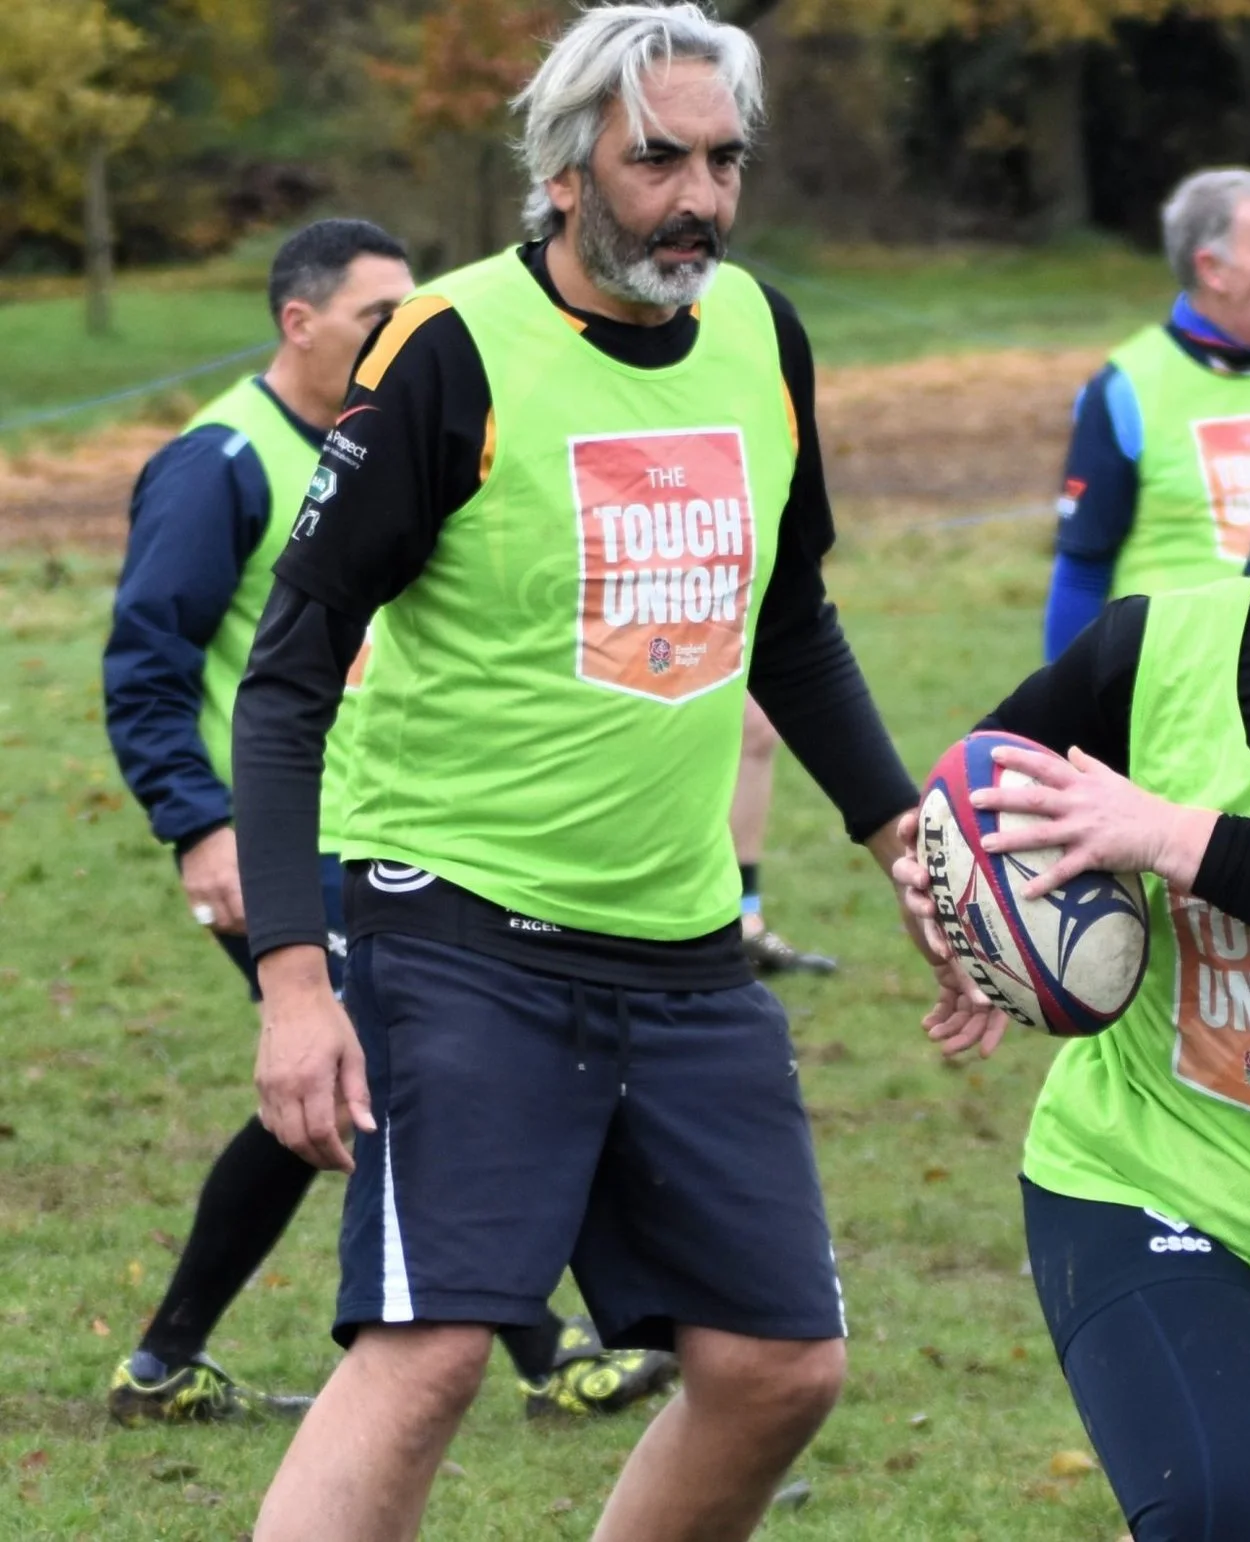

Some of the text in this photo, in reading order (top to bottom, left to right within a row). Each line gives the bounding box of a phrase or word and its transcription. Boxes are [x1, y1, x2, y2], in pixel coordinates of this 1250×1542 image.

[646, 467, 686, 488] THE
[593, 498, 743, 562] TOUCH
[603, 565, 739, 627] UNION
[509, 917, 562, 933] EXCEL
[924, 816, 1036, 1028] GILBERT
[1149, 1235, 1212, 1253] CSSC
